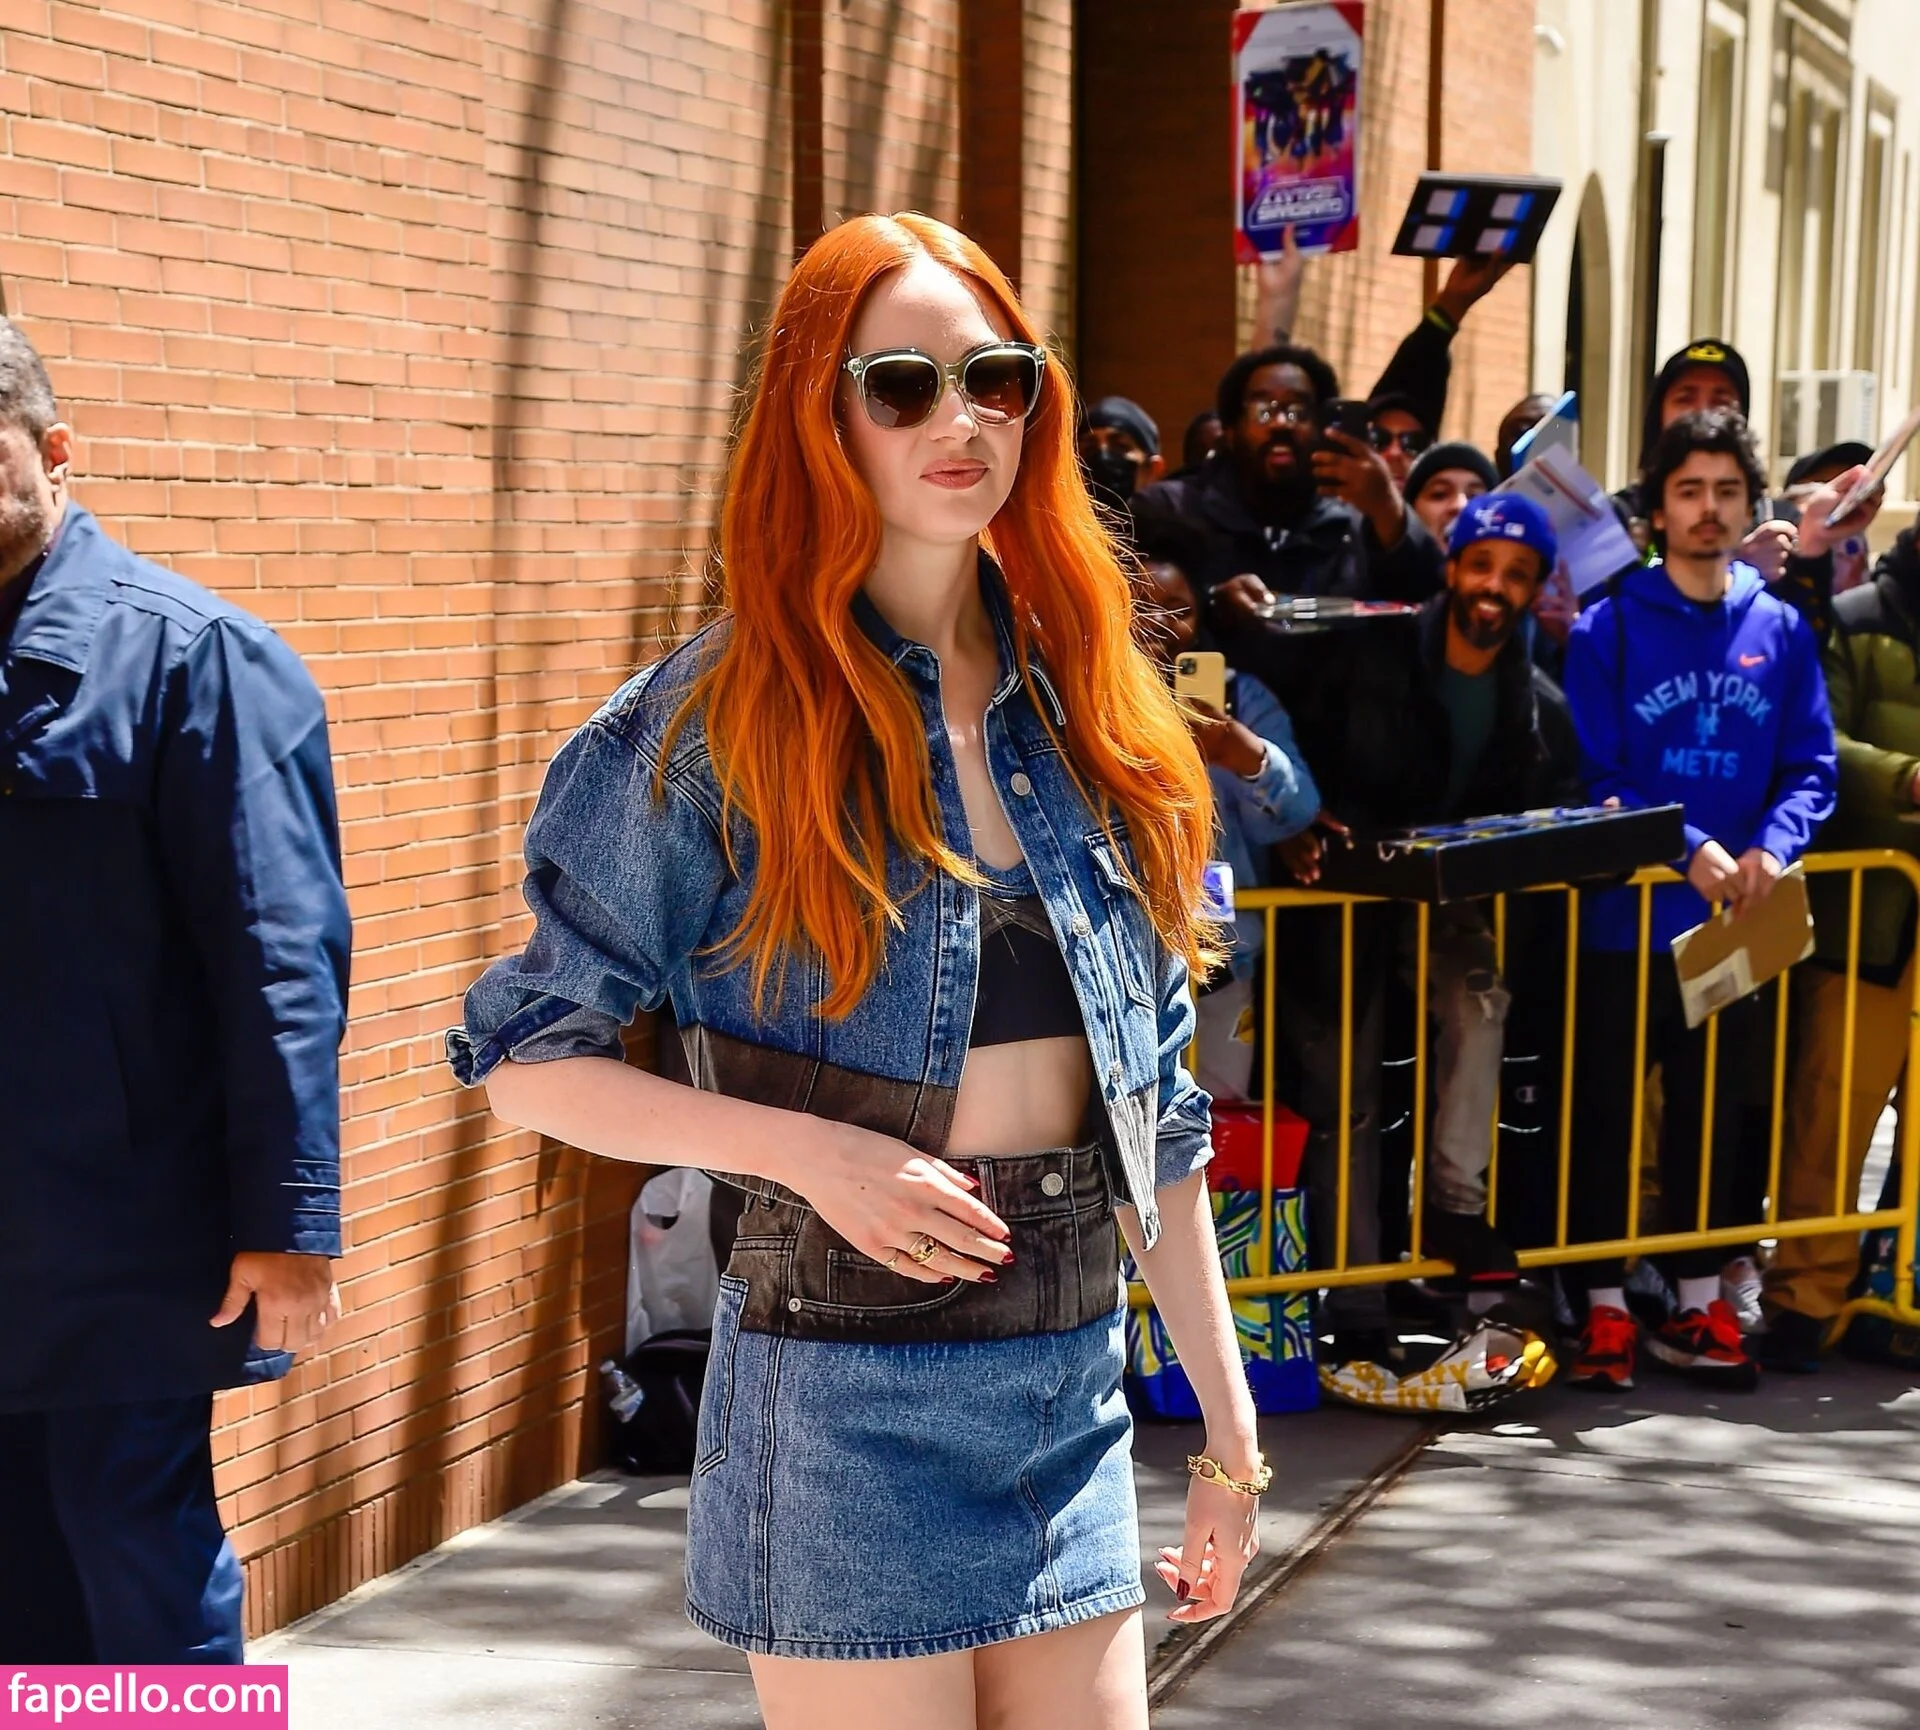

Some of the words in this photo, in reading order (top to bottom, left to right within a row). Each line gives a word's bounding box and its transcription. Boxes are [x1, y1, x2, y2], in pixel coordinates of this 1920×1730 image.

[1634, 670, 1697, 725] NEW
[1705, 670, 1772, 726] YORK
[1663, 748, 1739, 778] METS
